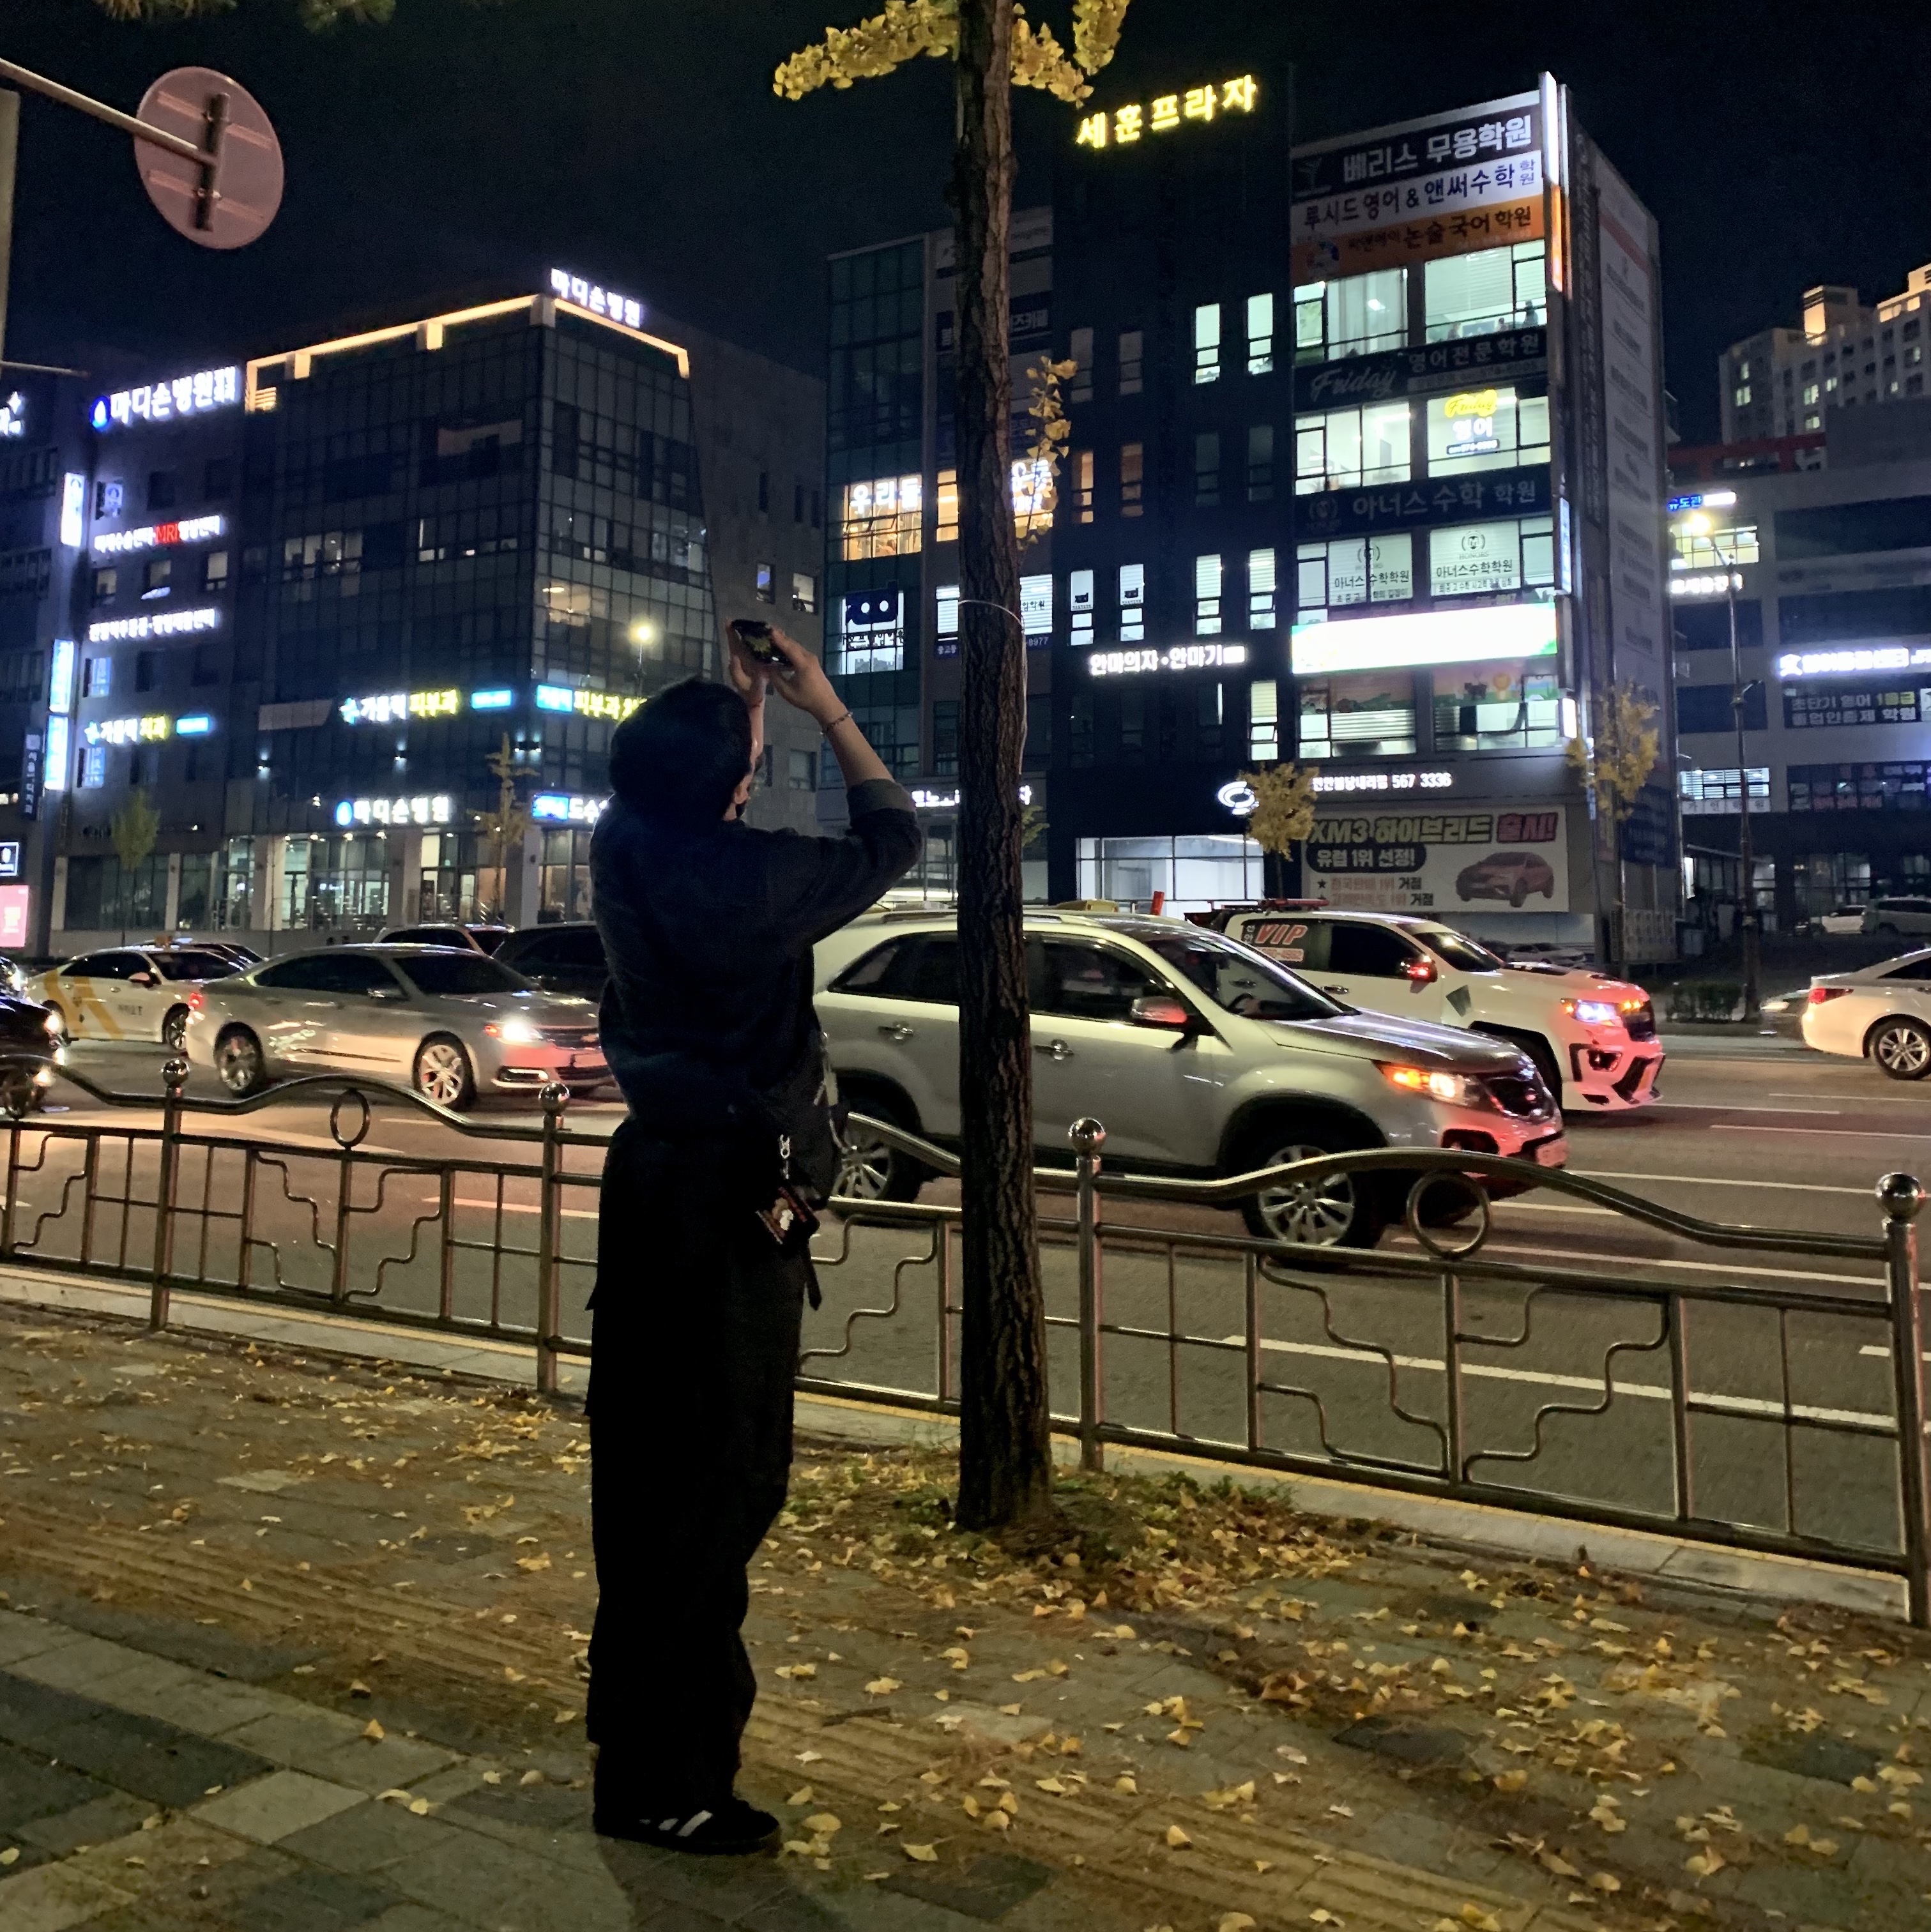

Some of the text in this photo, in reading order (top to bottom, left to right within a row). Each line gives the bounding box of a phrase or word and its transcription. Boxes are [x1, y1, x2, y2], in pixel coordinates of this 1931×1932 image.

[1076, 73, 1257, 149] 세훈프라자
[1343, 114, 1532, 183] 베리스 무용학원
[1304, 188, 1400, 231] 루시드영어
[1424, 164, 1515, 206] 앤써수학
[551, 268, 641, 328] 마디손병원
[111, 370, 213, 423] 마디손병원
[1311, 367, 1398, 402] Friday
[1447, 392, 1495, 416] Friday
[1452, 416, 1493, 441] 영어
[850, 477, 922, 513] 우리들
[1353, 481, 1486, 521] 아너스수학
[1436, 559, 1513, 578] 아너스수학학원
[409, 689, 459, 717] 피부과
[574, 690, 621, 720] 피부과
[1393, 773, 1416, 789] 567
[1420, 772, 1453, 788] 3336
[354, 796, 449, 824] 마디손병원
[1308, 818, 1370, 844] XM3
[1374, 814, 1493, 844] 하이브리드
[1317, 849, 1348, 868] 유럽
[1352, 848, 1373, 868] 1위
[1398, 876, 1422, 890] 거점
[1410, 893, 1434, 906] 거점
[1255, 924, 1308, 945] VIP
